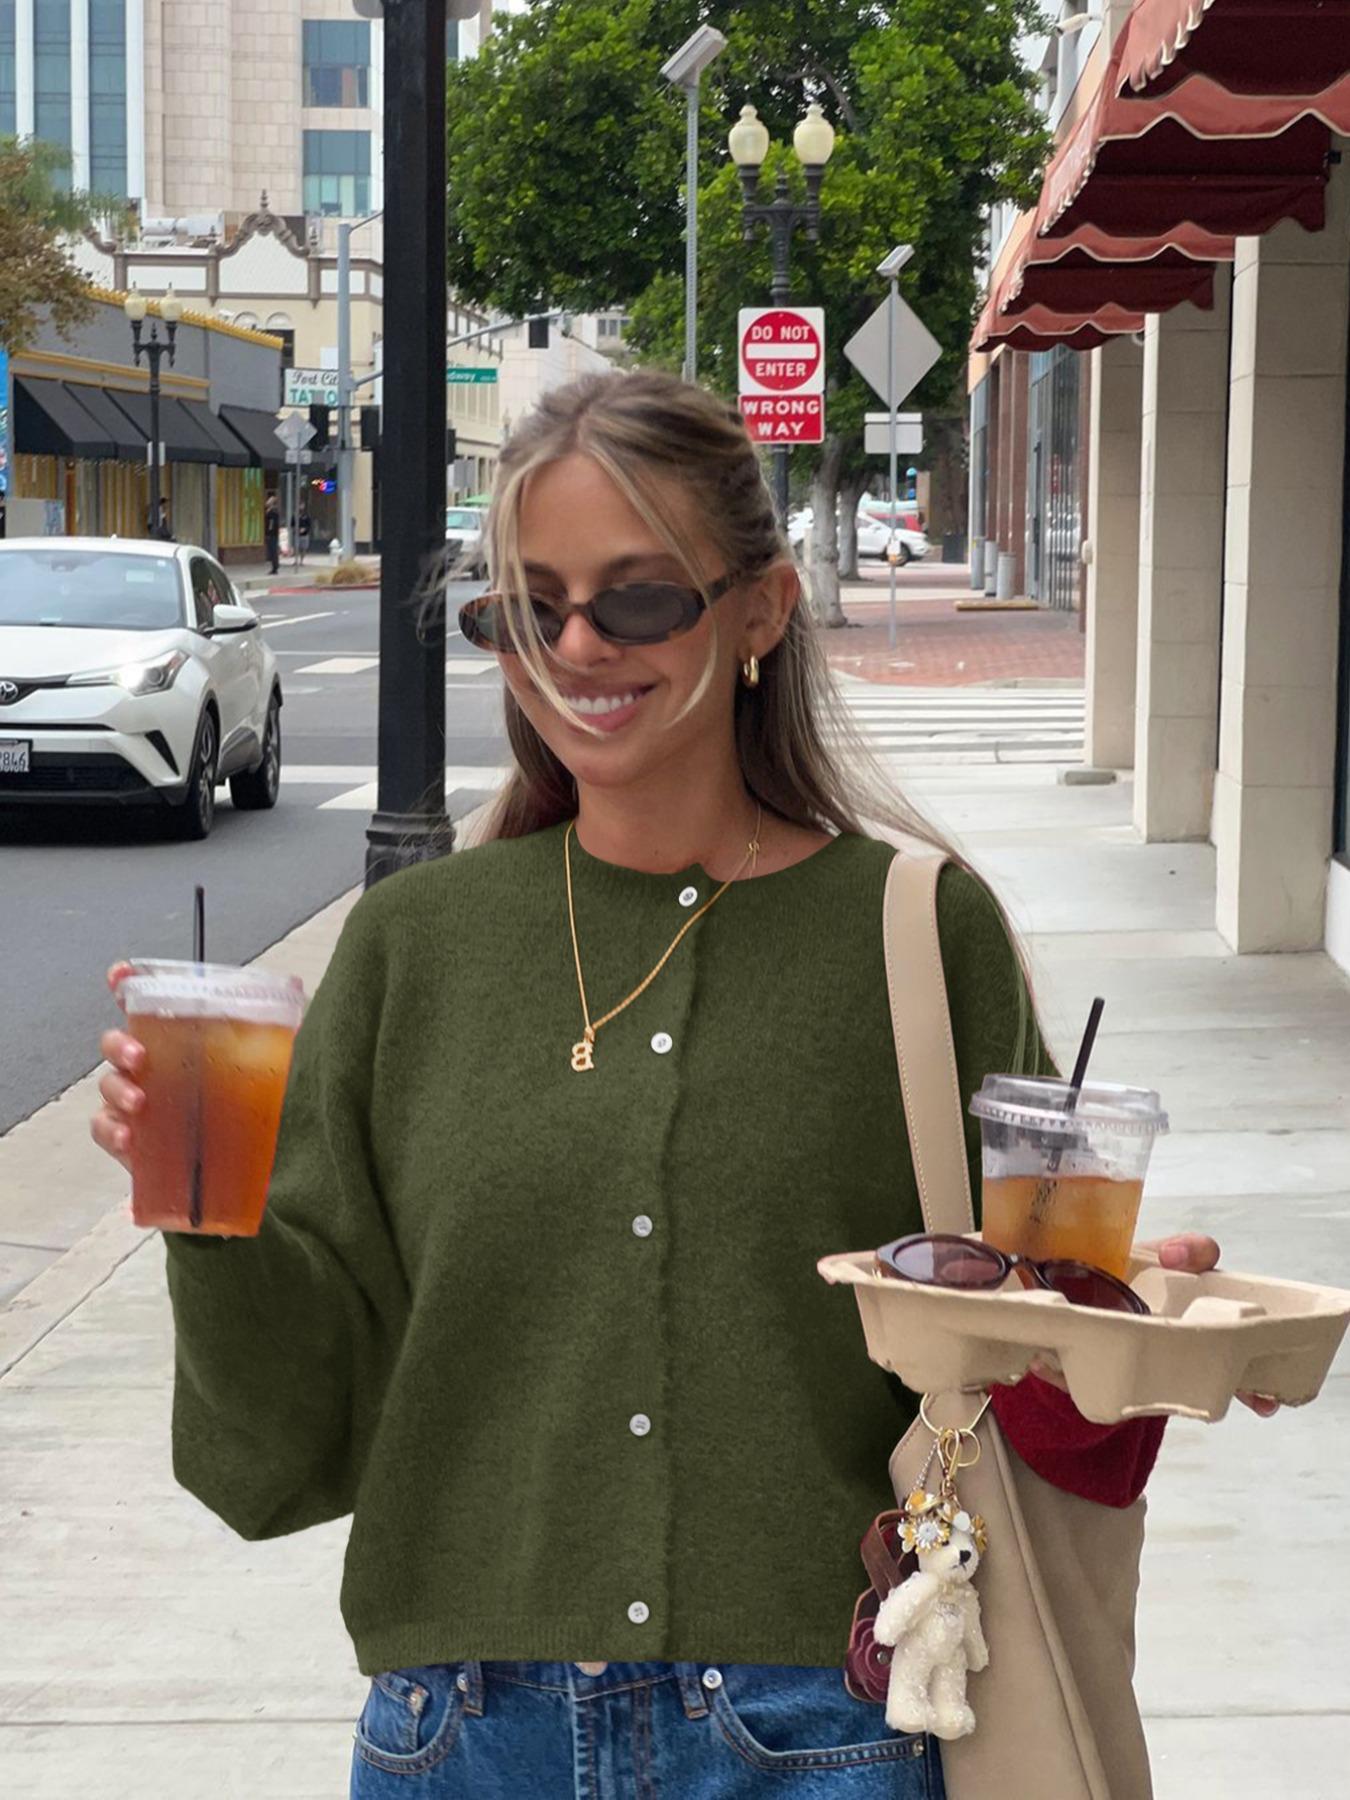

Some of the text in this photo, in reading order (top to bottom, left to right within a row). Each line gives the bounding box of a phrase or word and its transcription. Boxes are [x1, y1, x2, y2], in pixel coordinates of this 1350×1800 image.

[752, 325, 810, 340] DO NOT
[755, 362, 807, 377] ENTER
[321, 371, 339, 386] Cit
[743, 400, 820, 415] WRONG
[757, 421, 805, 436] WAY
[0, 751, 26, 769] 846
